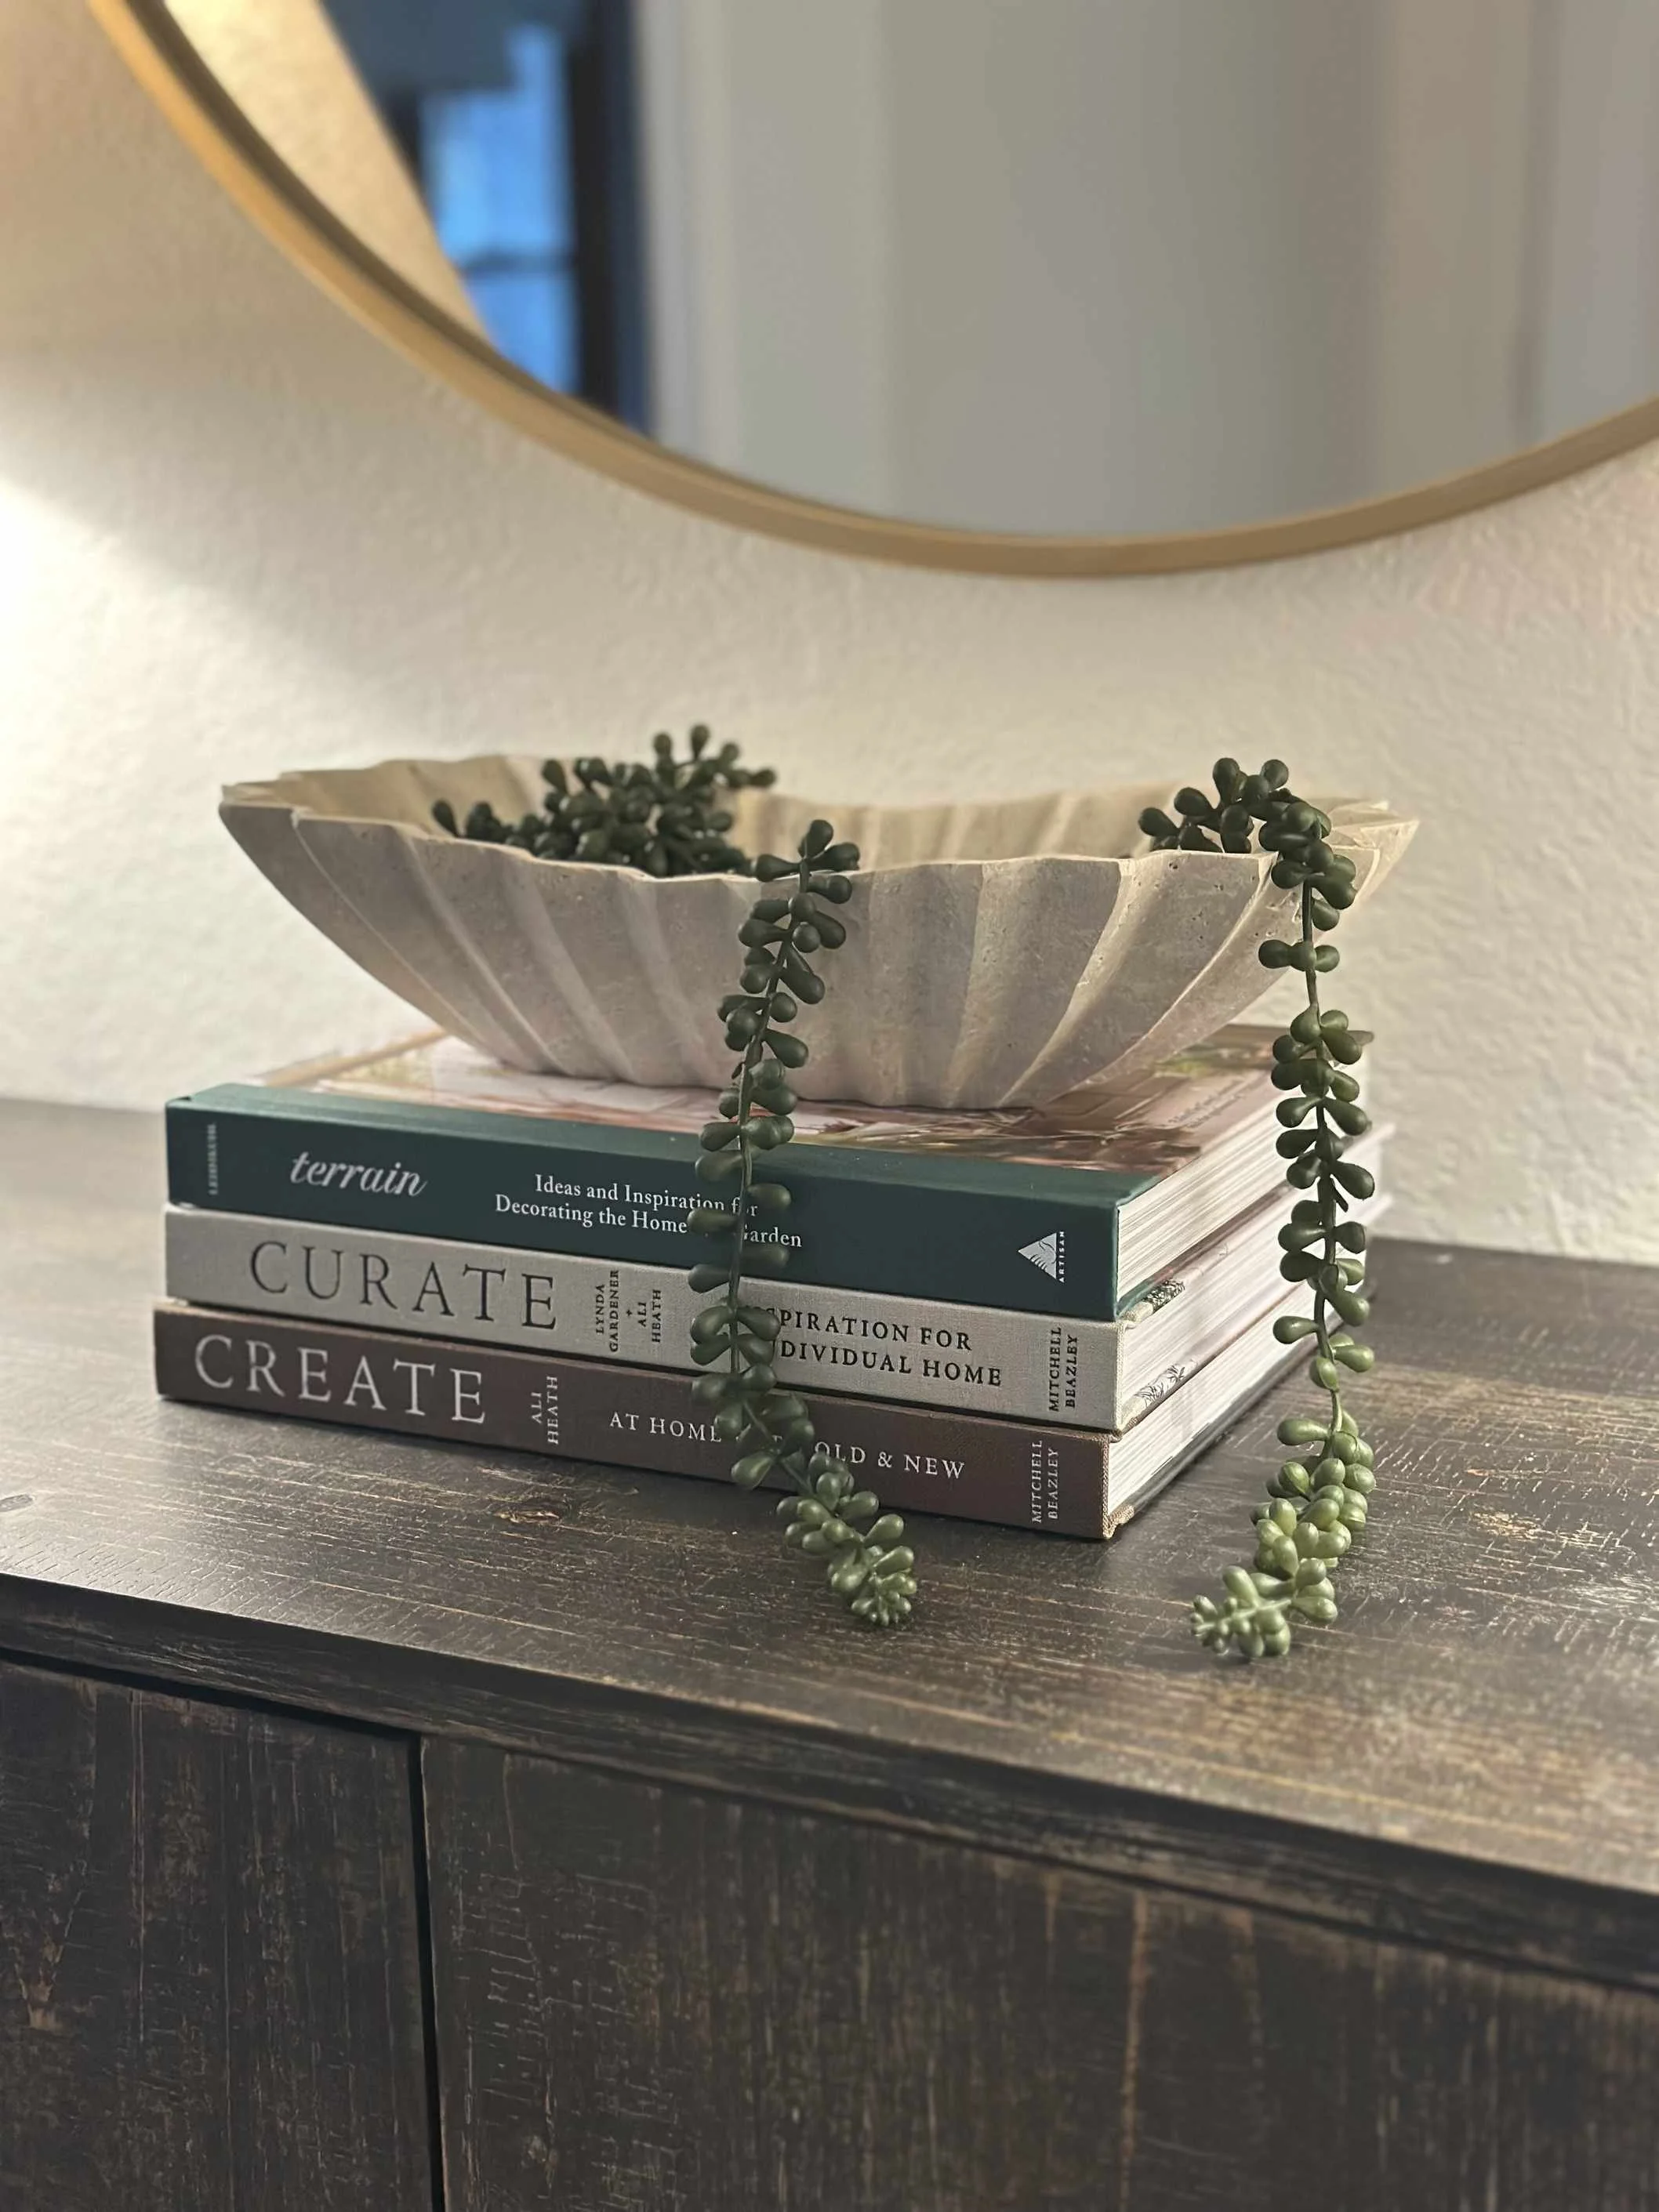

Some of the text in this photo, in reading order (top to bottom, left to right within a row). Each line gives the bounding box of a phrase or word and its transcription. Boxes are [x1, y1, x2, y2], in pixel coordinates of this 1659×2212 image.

[289, 1151, 428, 1197] terrain
[535, 1174, 758, 1217] Ideas and Inspiration fr
[495, 1194, 594, 1227] Decorating
[599, 1204, 626, 1227] the
[631, 1209, 688, 1235] Home
[250, 1241, 555, 1329] CURATE
[596, 1284, 606, 1336] LYNDA
[608, 1270, 619, 1352] GARDENER
[638, 1301, 648, 1327] ALI
[652, 1289, 662, 1343] HEATH
[766, 1307, 973, 1351] PIRATION FOR
[194, 1334, 486, 1425] CREATE
[772, 1340, 1002, 1387] DIVIDUAL HOME
[1048, 1326, 1062, 1412] MITCHELL
[1065, 1334, 1079, 1409] BEAZLEY
[531, 1392, 543, 1424] ALI
[546, 1376, 559, 1445] HEATH
[609, 1411, 640, 1431] AT
[877, 1451, 894, 1469] &
[903, 1454, 966, 1479] NEW
[1031, 1440, 1043, 1525] MITCHELL
[1047, 1448, 1058, 1519] BEAZLEY
